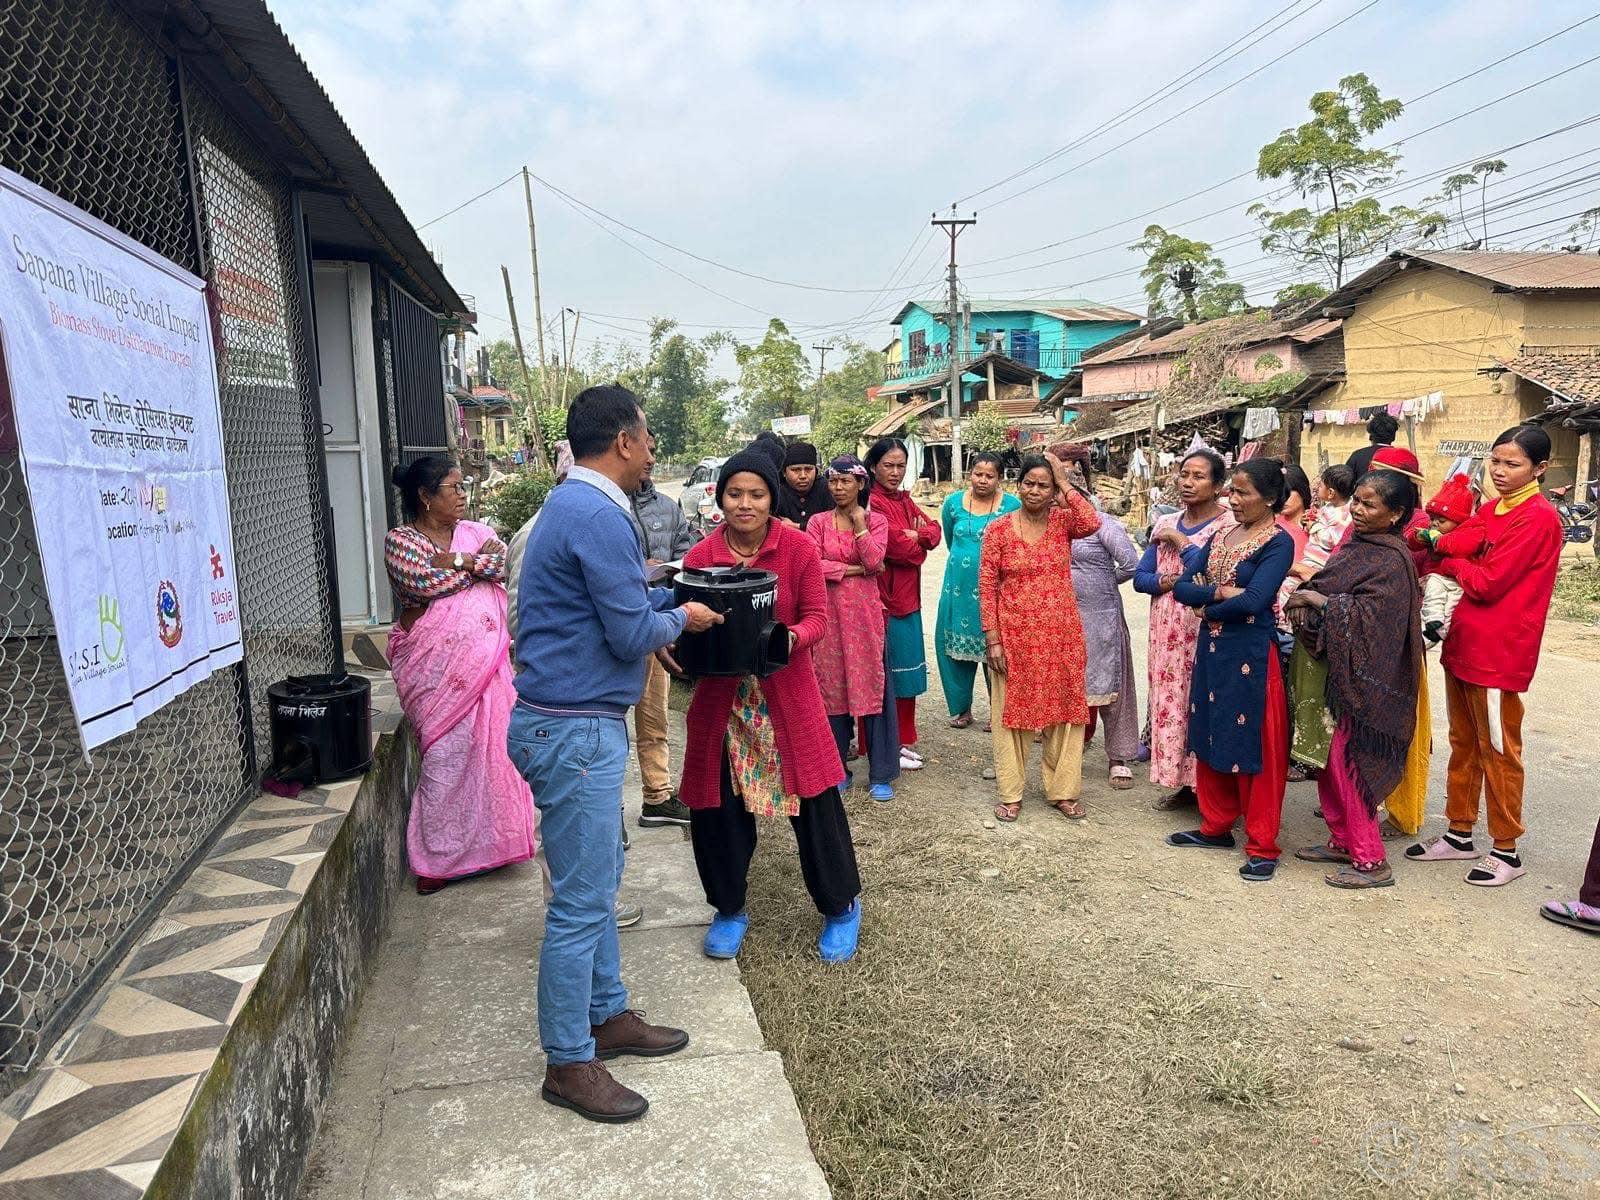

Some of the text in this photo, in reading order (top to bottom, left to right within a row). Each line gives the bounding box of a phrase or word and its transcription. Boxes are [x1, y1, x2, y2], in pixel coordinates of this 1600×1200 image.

[13, 234, 77, 294] Sapana
[78, 263, 130, 322] Village
[130, 288, 165, 328] Social
[166, 303, 200, 346] Impact
[1471, 442, 1493, 452] HOM
[100, 489, 120, 507] ate:
[107, 521, 138, 540] ocation
[211, 588, 233, 607] Riksja
[752, 590, 774, 610] सपना
[214, 609, 236, 626] Travel
